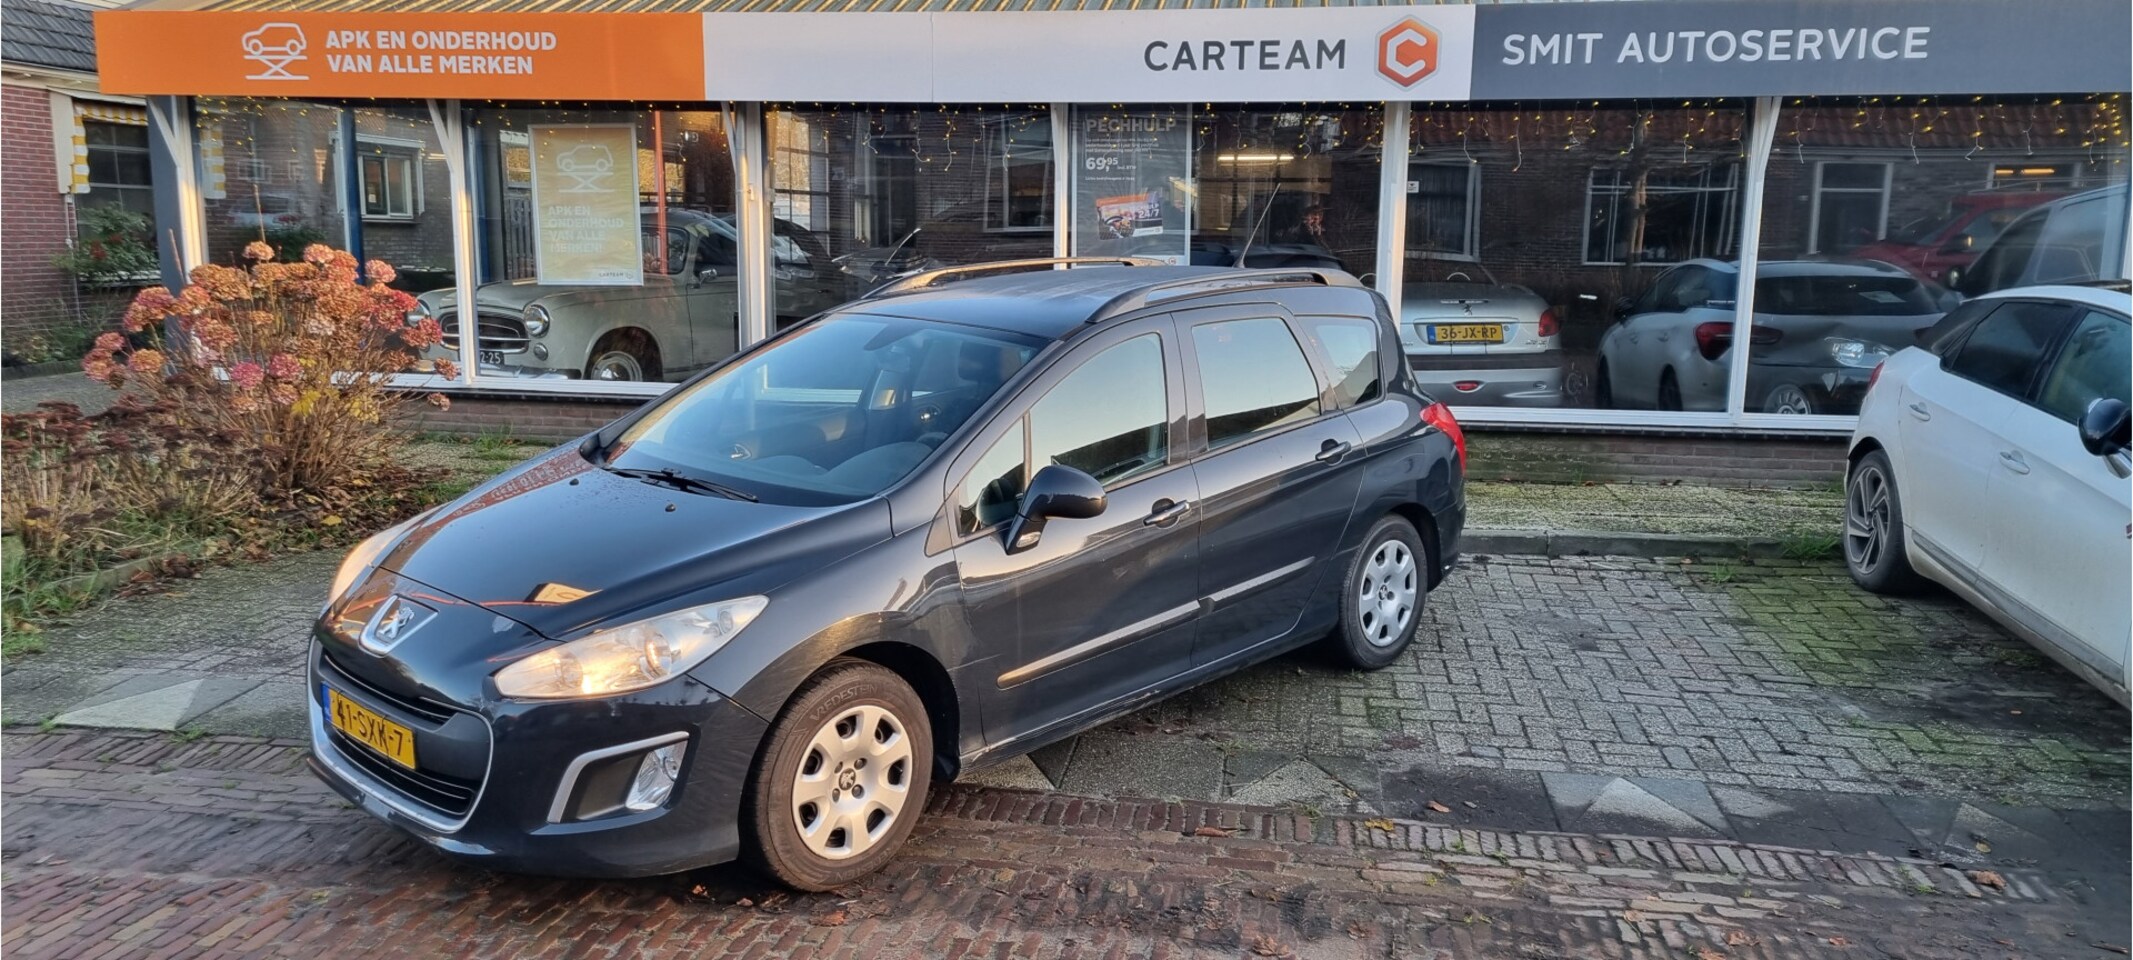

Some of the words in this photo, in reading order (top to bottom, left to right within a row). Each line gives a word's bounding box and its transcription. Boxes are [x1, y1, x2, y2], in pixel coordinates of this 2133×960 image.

[326, 30, 371, 49] APK
[376, 31, 406, 49] EN
[411, 31, 557, 51] ONDERHOUD
[1502, 33, 1603, 66] SMIT
[1616, 26, 1931, 63] AUTOSERVICE
[1144, 38, 1346, 71] CARTEAM
[326, 54, 372, 73] VAN
[378, 54, 434, 73] ALLE
[439, 55, 533, 75] MERKEN
[1086, 118, 1177, 133] PECHHULP
[549, 205, 573, 216] APK
[575, 206, 591, 216] EN
[549, 217, 625, 229] ONDERHOUD
[550, 230, 574, 242] VAN
[577, 231, 606, 242] ALLE
[1441, 326, 1499, 340] 36-JX-RP
[337, 699, 404, 757] 41-SXK-7
